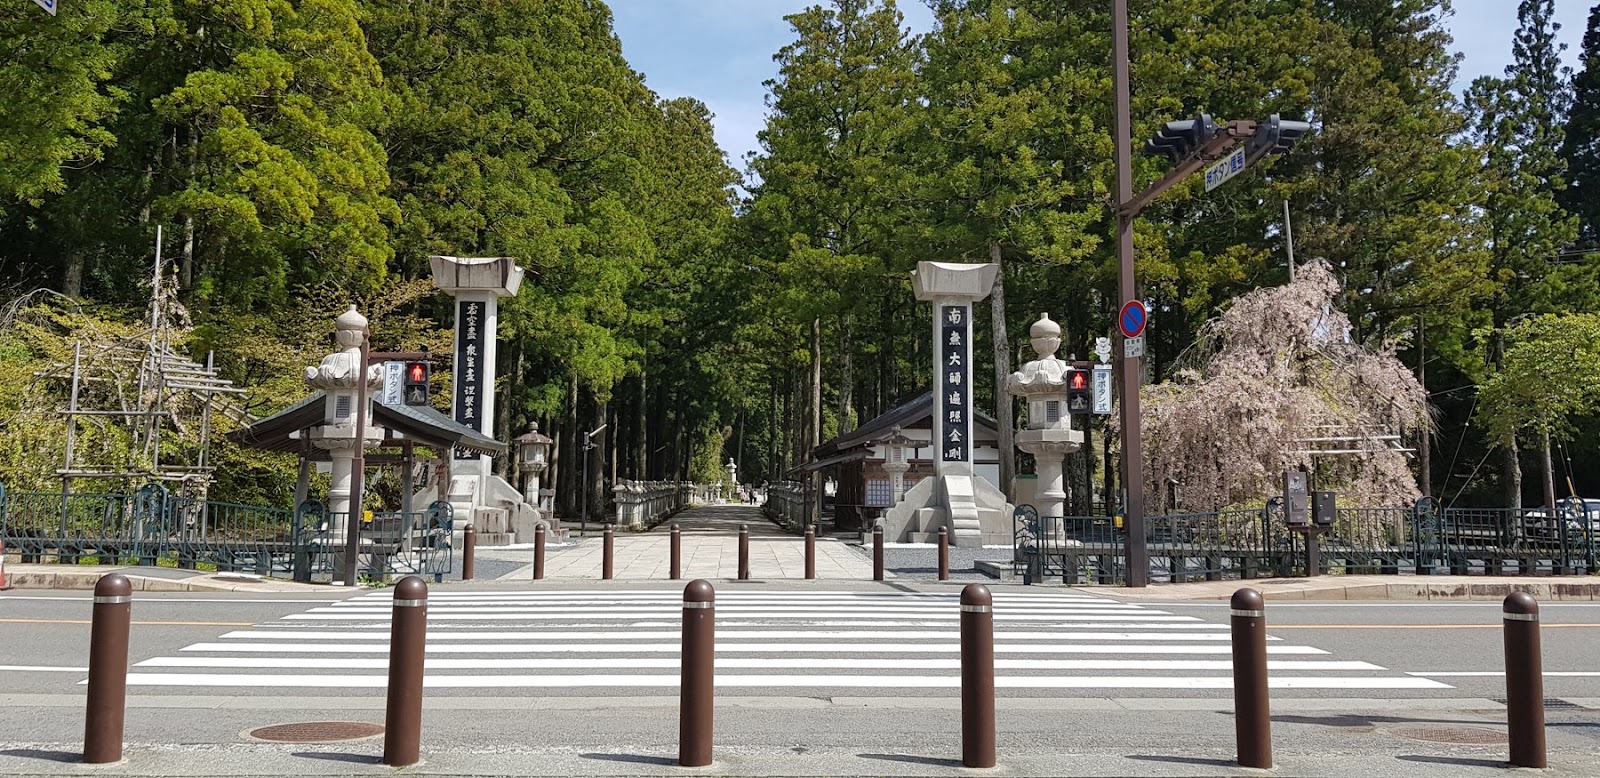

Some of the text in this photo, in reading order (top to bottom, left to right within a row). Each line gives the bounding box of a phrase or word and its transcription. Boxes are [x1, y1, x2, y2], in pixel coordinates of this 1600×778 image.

[1206, 151, 1244, 189] 押ボタン信号
[387, 364, 399, 404] 押ボタン式
[1097, 372, 1108, 411] 押ボタン式
